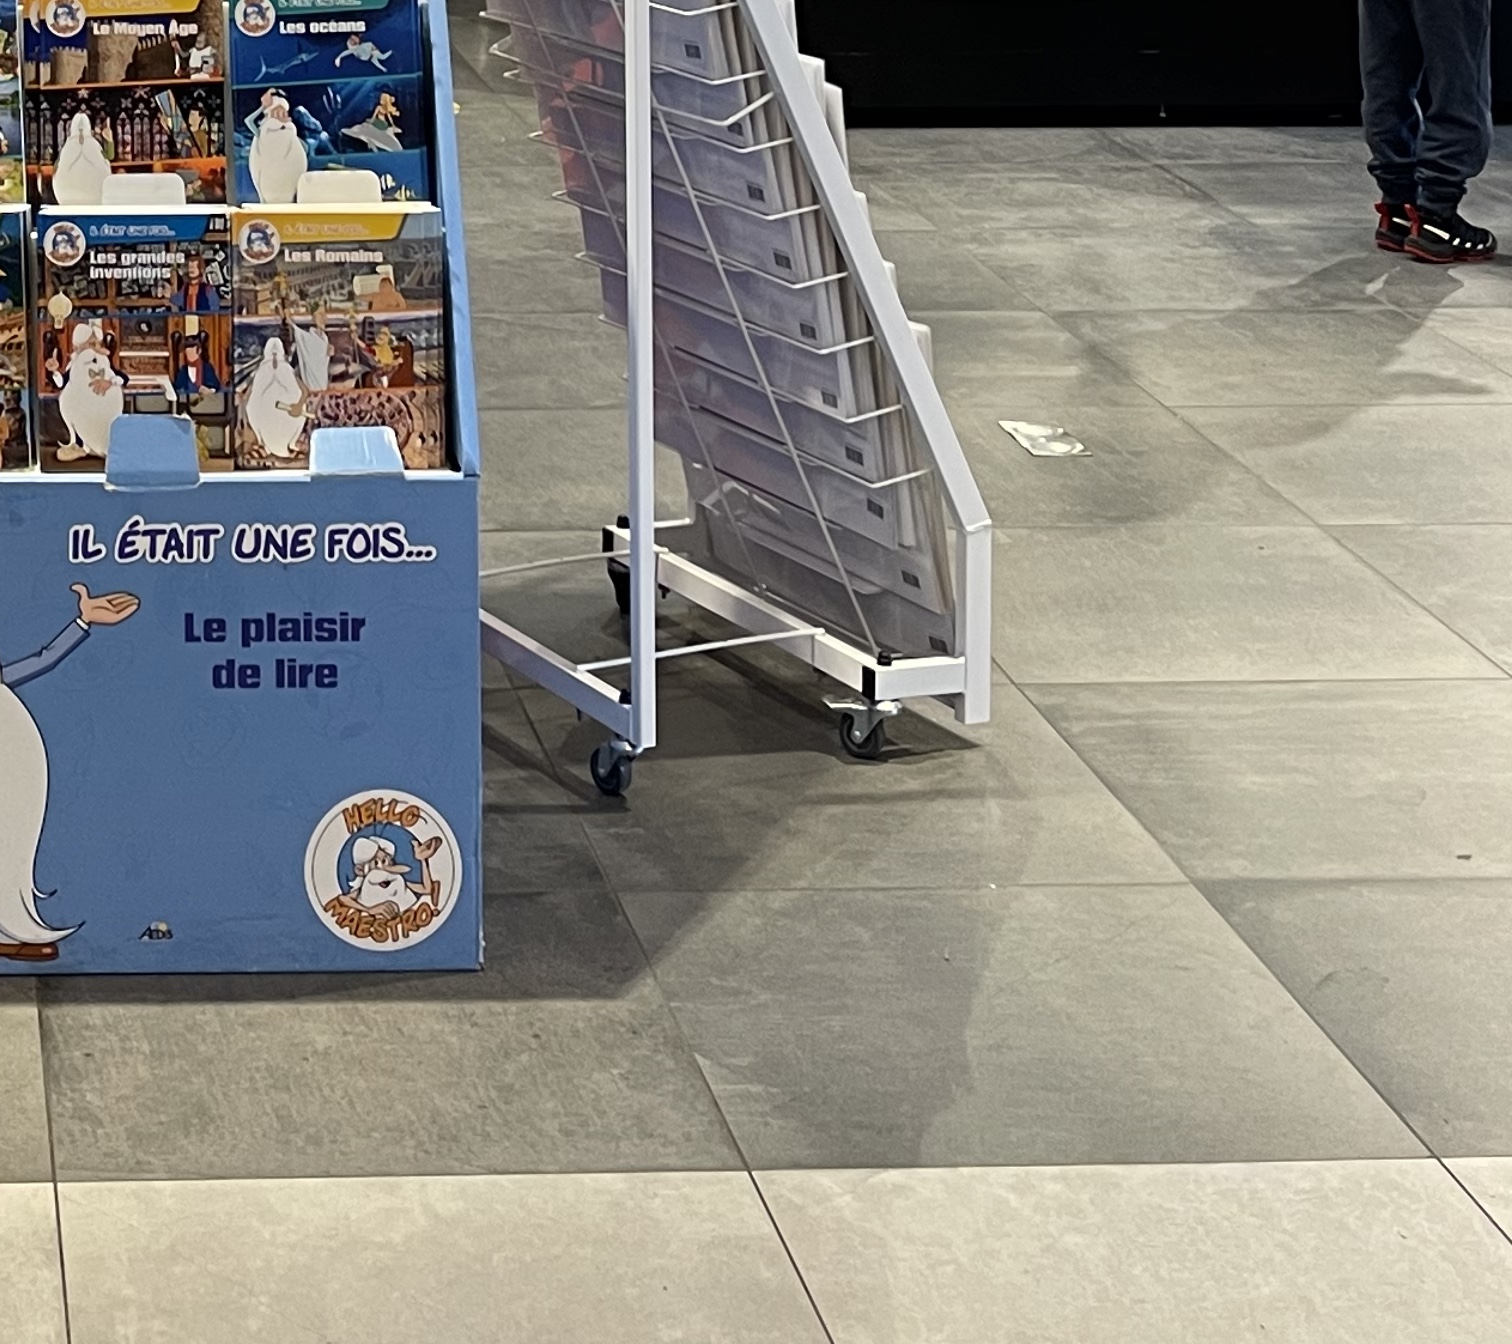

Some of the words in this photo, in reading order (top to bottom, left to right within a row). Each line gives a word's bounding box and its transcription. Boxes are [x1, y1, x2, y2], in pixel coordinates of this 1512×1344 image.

[93, 22, 110, 35] Le
[113, 21, 165, 36] Moyen
[279, 21, 305, 34] Les
[309, 19, 366, 33] océans
[90, 250, 117, 264] Les
[121, 251, 185, 265] grandes
[284, 249, 312, 262] Les
[315, 249, 383, 262] Romains
[89, 265, 171, 279] inventions
[70, 527, 103, 561] IL
[117, 518, 223, 561] ÉTAIT
[234, 526, 313, 560] UNE
[326, 525, 435, 560] FOIS...
[184, 613, 226, 643] Le
[242, 612, 365, 648] plaisir
[212, 659, 262, 690] de
[276, 658, 338, 690] lire
[342, 797, 424, 833] HELLO
